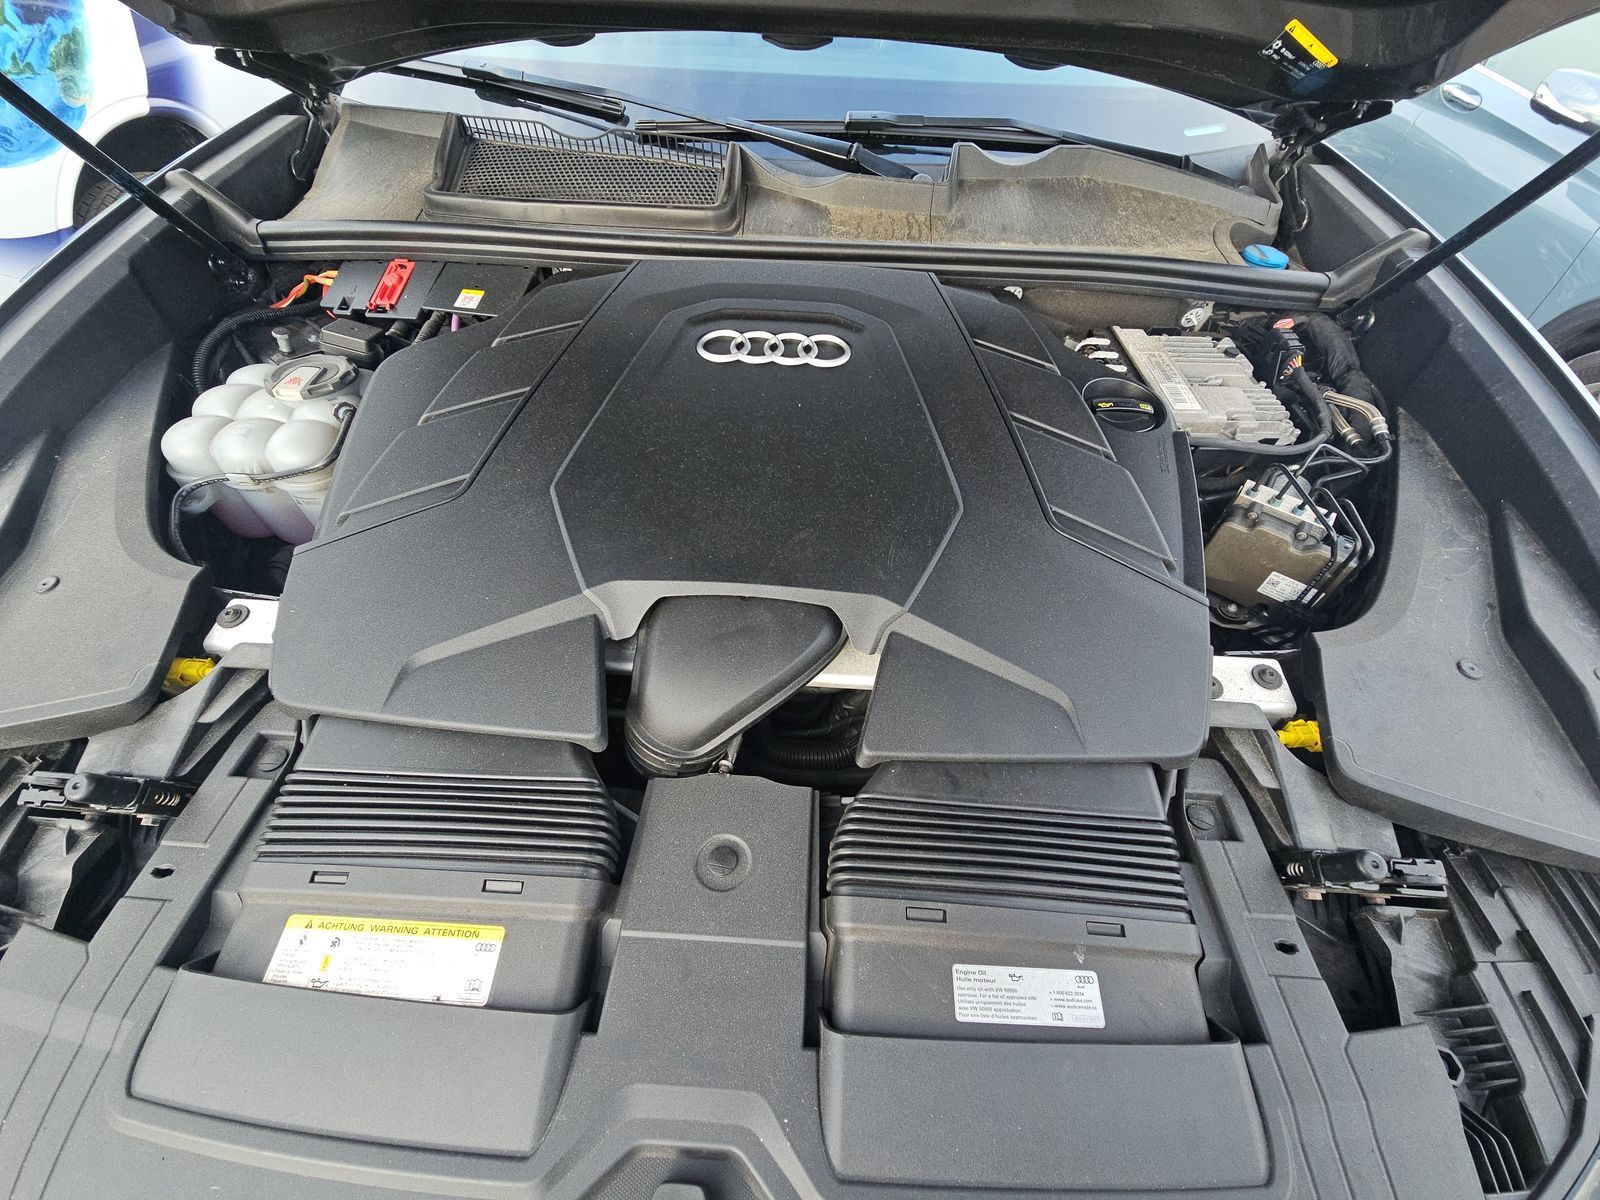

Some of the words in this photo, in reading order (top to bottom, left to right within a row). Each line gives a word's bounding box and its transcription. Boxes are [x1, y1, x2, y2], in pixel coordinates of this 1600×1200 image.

[318, 921, 365, 932] ACHTUNG
[370, 924, 419, 935] WARNING
[424, 927, 480, 939] ATTENTION
